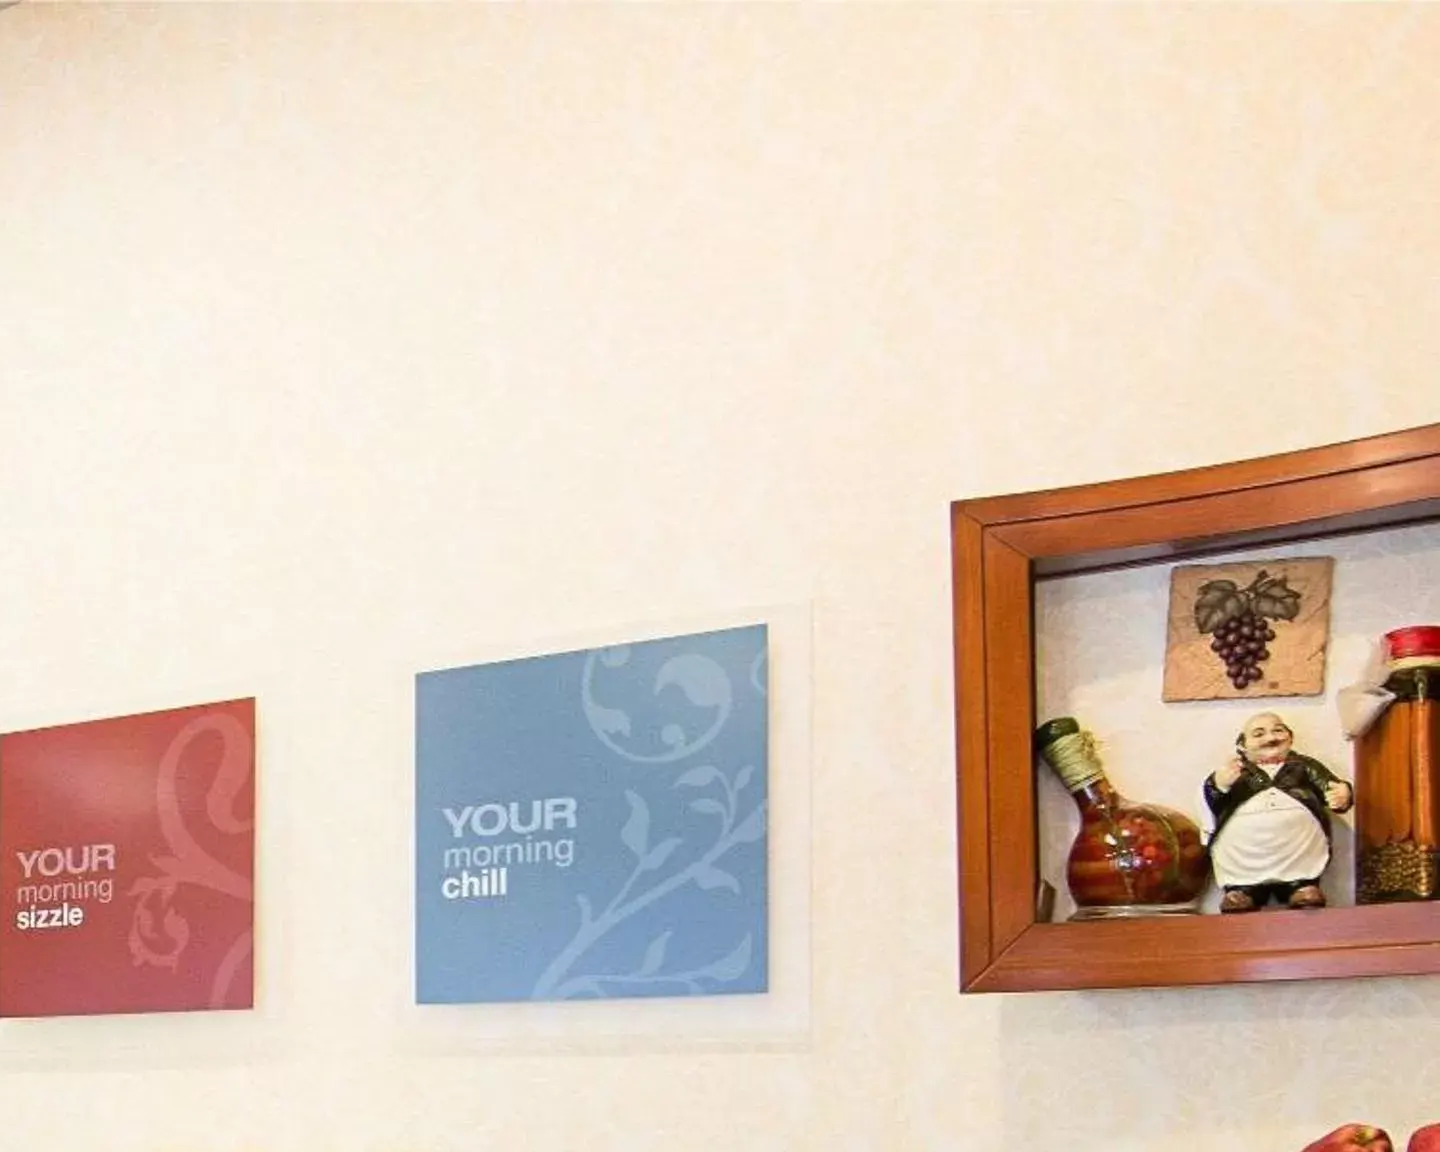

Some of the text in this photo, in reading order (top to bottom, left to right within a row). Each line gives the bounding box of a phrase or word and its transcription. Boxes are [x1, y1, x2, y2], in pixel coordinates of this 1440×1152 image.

[441, 798, 577, 838] YOUR
[16, 844, 115, 878] YOUR
[444, 835, 574, 867] morning
[18, 876, 112, 903] morning
[441, 867, 507, 899] chill
[16, 902, 84, 930] sizzle
